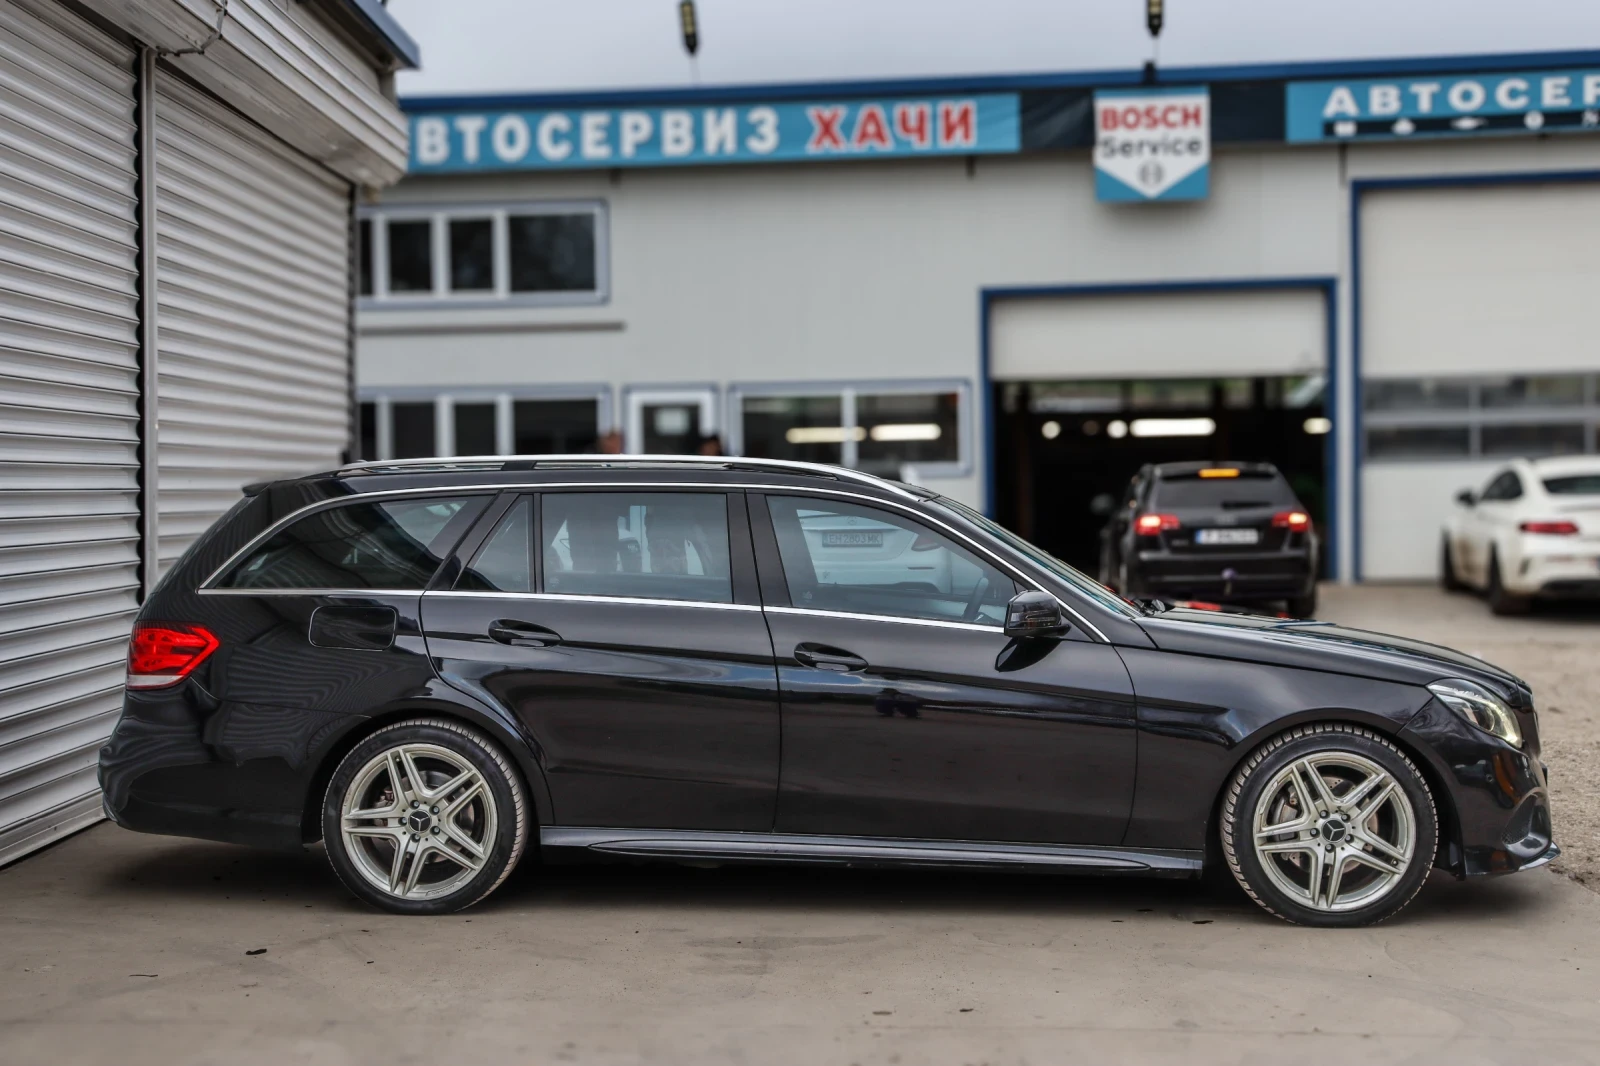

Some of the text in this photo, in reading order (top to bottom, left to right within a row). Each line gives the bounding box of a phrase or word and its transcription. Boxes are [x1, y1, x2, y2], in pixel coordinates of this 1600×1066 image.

[1101, 106, 1202, 131] BOSCH
[416, 101, 977, 165] ВТОСЕРВИЗ ХАЧИ
[1101, 136, 1202, 158] Service
